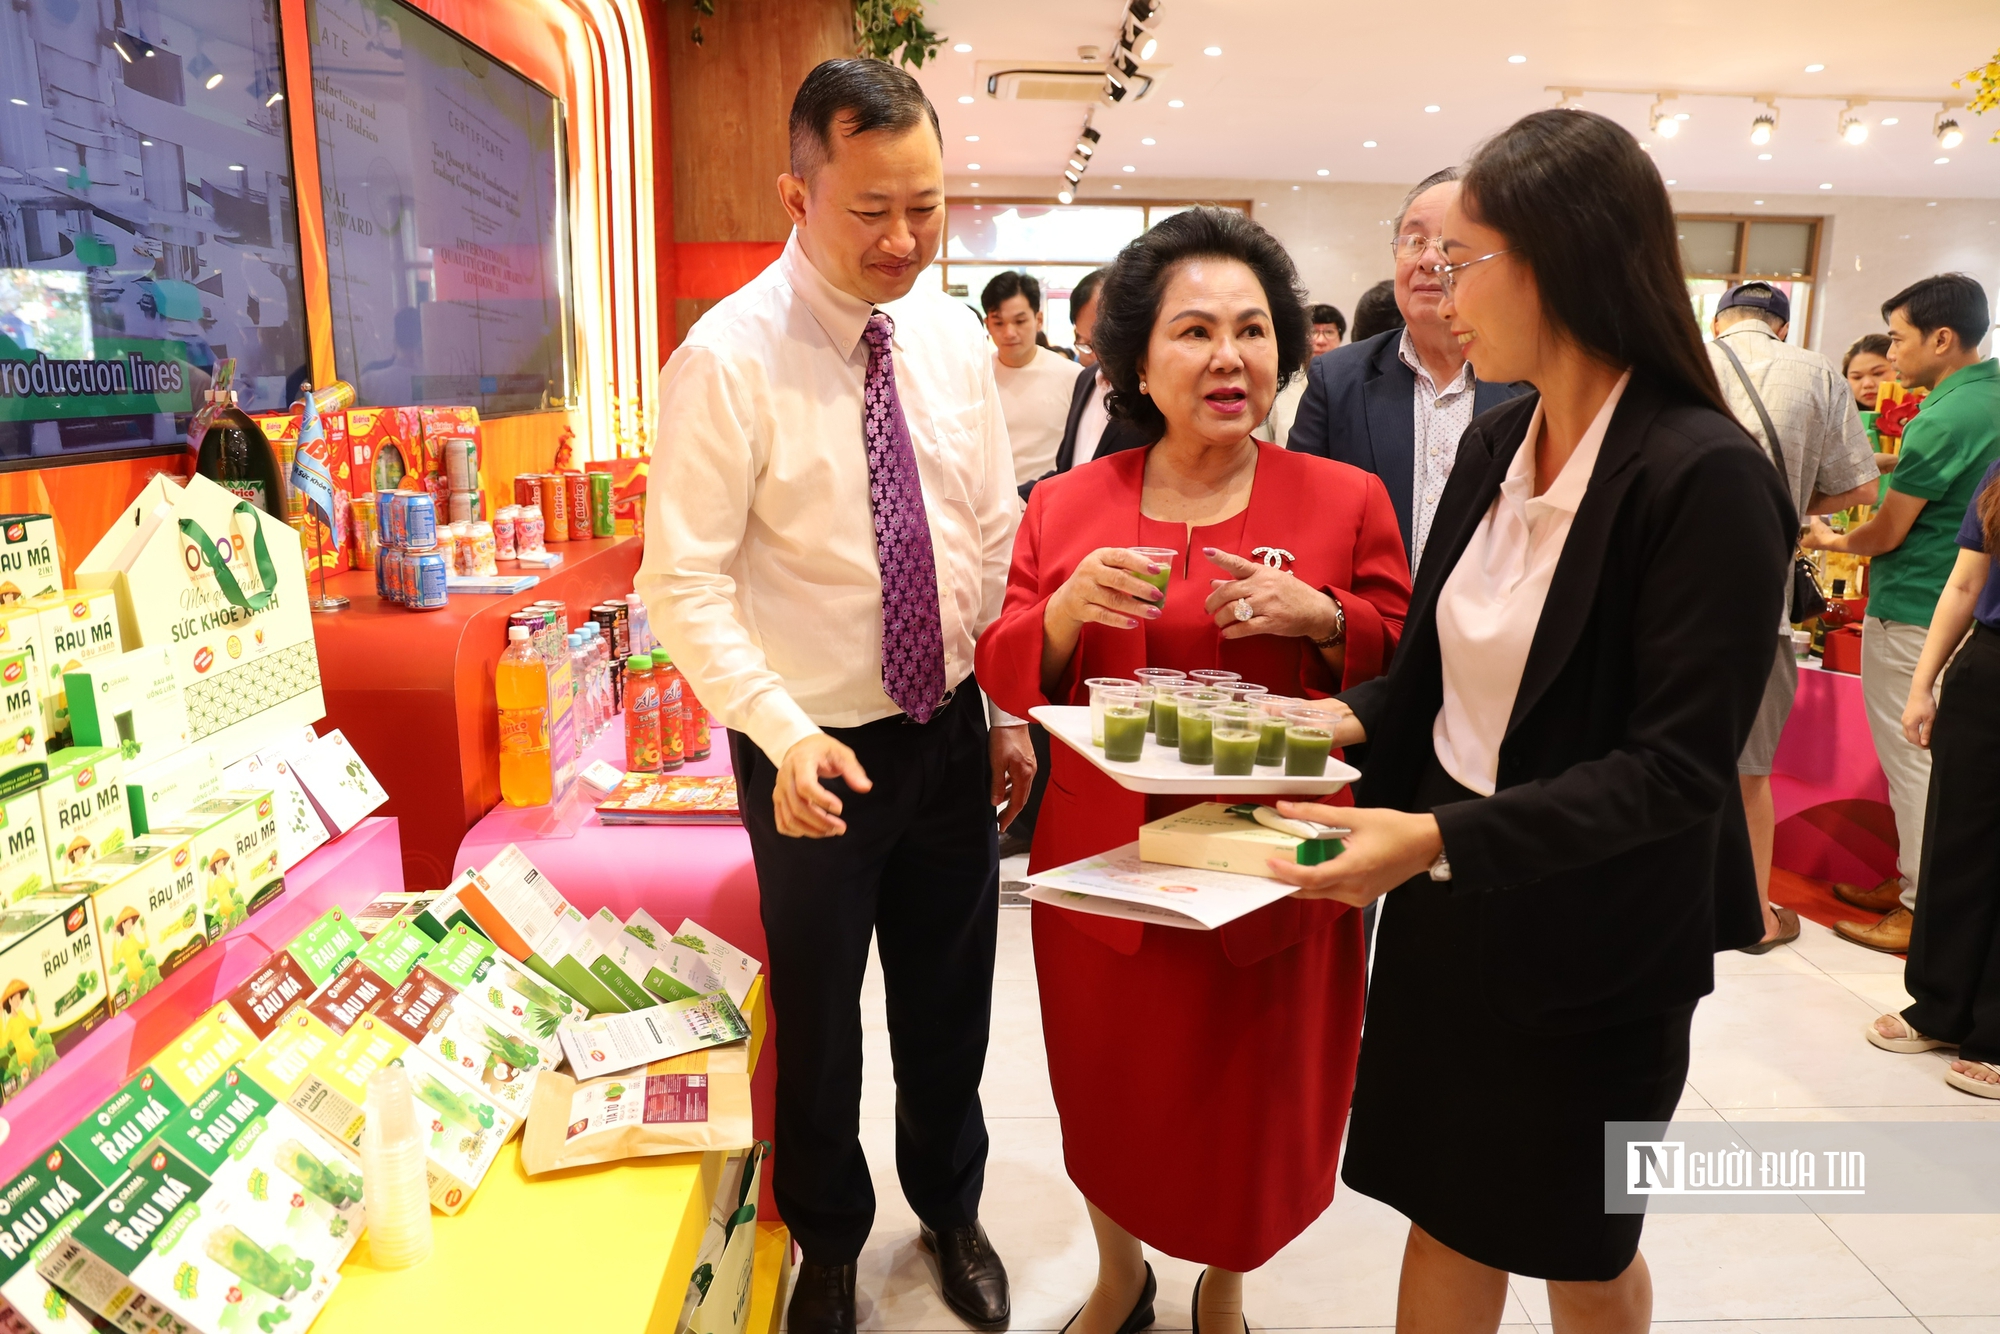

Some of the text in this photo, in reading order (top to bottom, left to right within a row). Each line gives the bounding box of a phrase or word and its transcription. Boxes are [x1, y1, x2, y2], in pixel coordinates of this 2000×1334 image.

[360, 103, 376, 120] and
[346, 113, 378, 143] Bidrico
[448, 110, 504, 161] CERTIFICATE
[331, 211, 373, 236] AWARD
[441, 247, 476, 269] QUALITY
[477, 259, 502, 279] CROWN
[456, 237, 511, 268] INTERNATIONAL
[463, 270, 493, 290] LONDON
[0, 352, 183, 394] roduction lines
[353, 414, 371, 424] Bidrico
[555, 486, 565, 519] Bidrico
[575, 483, 584, 519] Bidrico
[0, 539, 51, 573] AU MÁ
[38, 566, 54, 576] 2IN1
[55, 615, 113, 653] RAU MÁ
[171, 617, 199, 643] SỨC
[110, 675, 130, 687] ORAMA
[146, 689, 163, 700] UỐNG
[153, 673, 175, 687] RAU MÁ
[6, 682, 32, 713] MÁ
[502, 722, 528, 735] drico
[198, 781, 209, 791] RAU
[59, 776, 119, 829] RAU MÁ
[8, 817, 35, 856] MÁ
[236, 814, 276, 856] RAU MÁ
[149, 865, 194, 912] RAU MÁ
[43, 927, 92, 978] RAU MÁ
[311, 926, 353, 970] RAU MÁ
[384, 932, 423, 972] RAU MÁ
[448, 938, 485, 977] RAU MÁ
[257, 968, 274, 984] ORAMA
[333, 976, 350, 991] ORAMA
[399, 982, 412, 997] ORAMA
[703, 975, 719, 993] Bột
[253, 972, 302, 1023] RAU MÁ
[334, 978, 381, 1025] RAU MÁ
[401, 984, 444, 1028] RAU MÁ
[432, 1016, 443, 1027] CỐT
[185, 1051, 220, 1087] RAU
[214, 1029, 242, 1060] MÁ
[273, 1031, 327, 1085] RAU MÁ
[345, 1055, 377, 1087] RAU
[367, 1035, 393, 1061] MÁ
[107, 1093, 132, 1114] ORAMA
[198, 1089, 220, 1111] ORAMA
[296, 1080, 322, 1109] RAU MÁ
[99, 1095, 170, 1165] RAU MÁ
[196, 1114, 237, 1155] RAU
[226, 1089, 259, 1123] MÁ
[7, 1174, 37, 1202] ORAMA
[119, 1175, 145, 1201] ORAMA
[0, 1175, 82, 1261] RAU MÁ
[114, 1202, 164, 1252] RAU
[151, 1173, 191, 1212] MÁ
[157, 1217, 188, 1249] NGUYÊN
[46, 1244, 81, 1279] RAU MÁ
